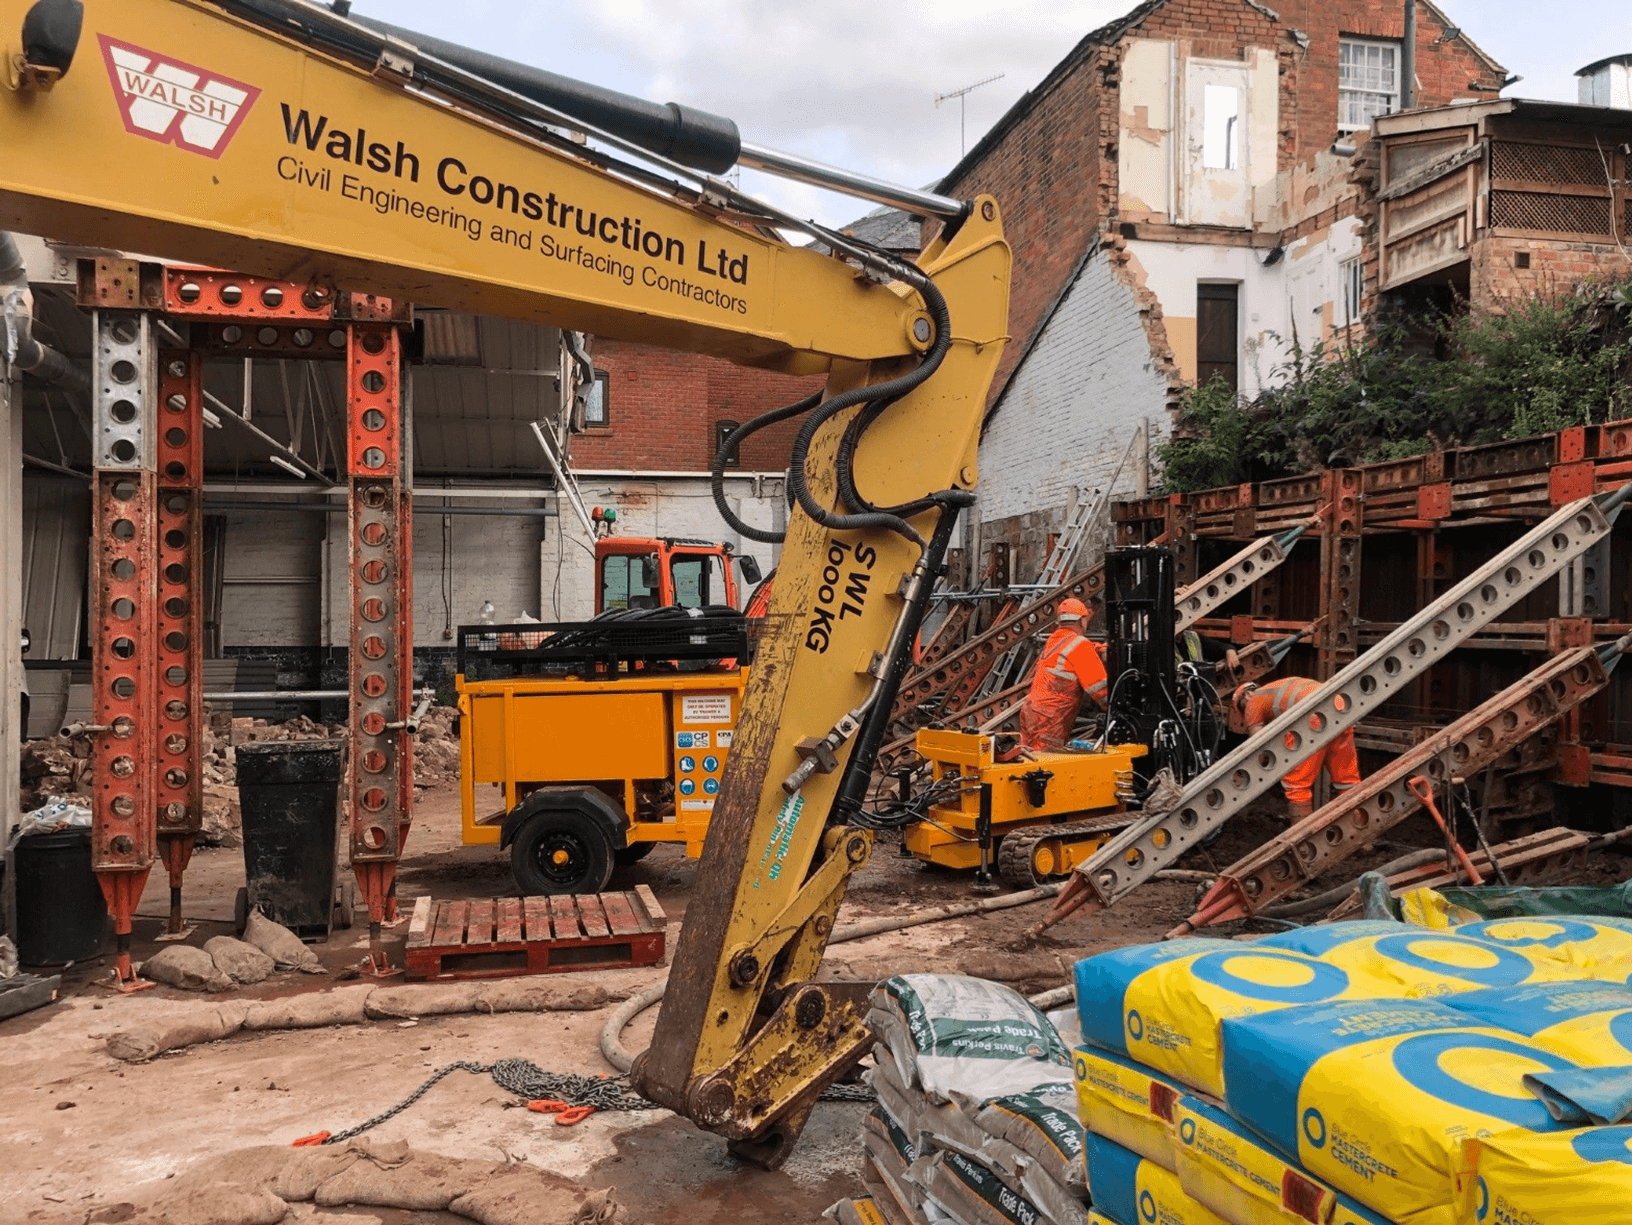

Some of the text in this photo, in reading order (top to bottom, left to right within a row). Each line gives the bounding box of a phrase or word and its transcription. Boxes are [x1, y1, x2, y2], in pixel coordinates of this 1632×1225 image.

[125, 70, 227, 121] WALSH
[280, 102, 749, 285] Walsh Construction Ltd
[276, 155, 748, 315] Civil Engineering and Surfacing Contractors
[839, 541, 877, 621] SWL
[693, 732, 708, 740] CP
[777, 795, 806, 860] Automatic
[952, 1039, 1026, 1055] Travis Perkins
[1004, 1025, 1043, 1039] Trade
[1041, 1112, 1067, 1133] Trade
[1060, 1130, 1082, 1153] Pack
[965, 1163, 983, 1184] Perkins
[1196, 1142, 1281, 1197] MASTERCRETE CEMENT
[1331, 1134, 1398, 1179] MASTERCRETE
[1331, 1146, 1376, 1183] CEMENT
[999, 1187, 1018, 1214] Trade
[1496, 1194, 1519, 1217] Blue
